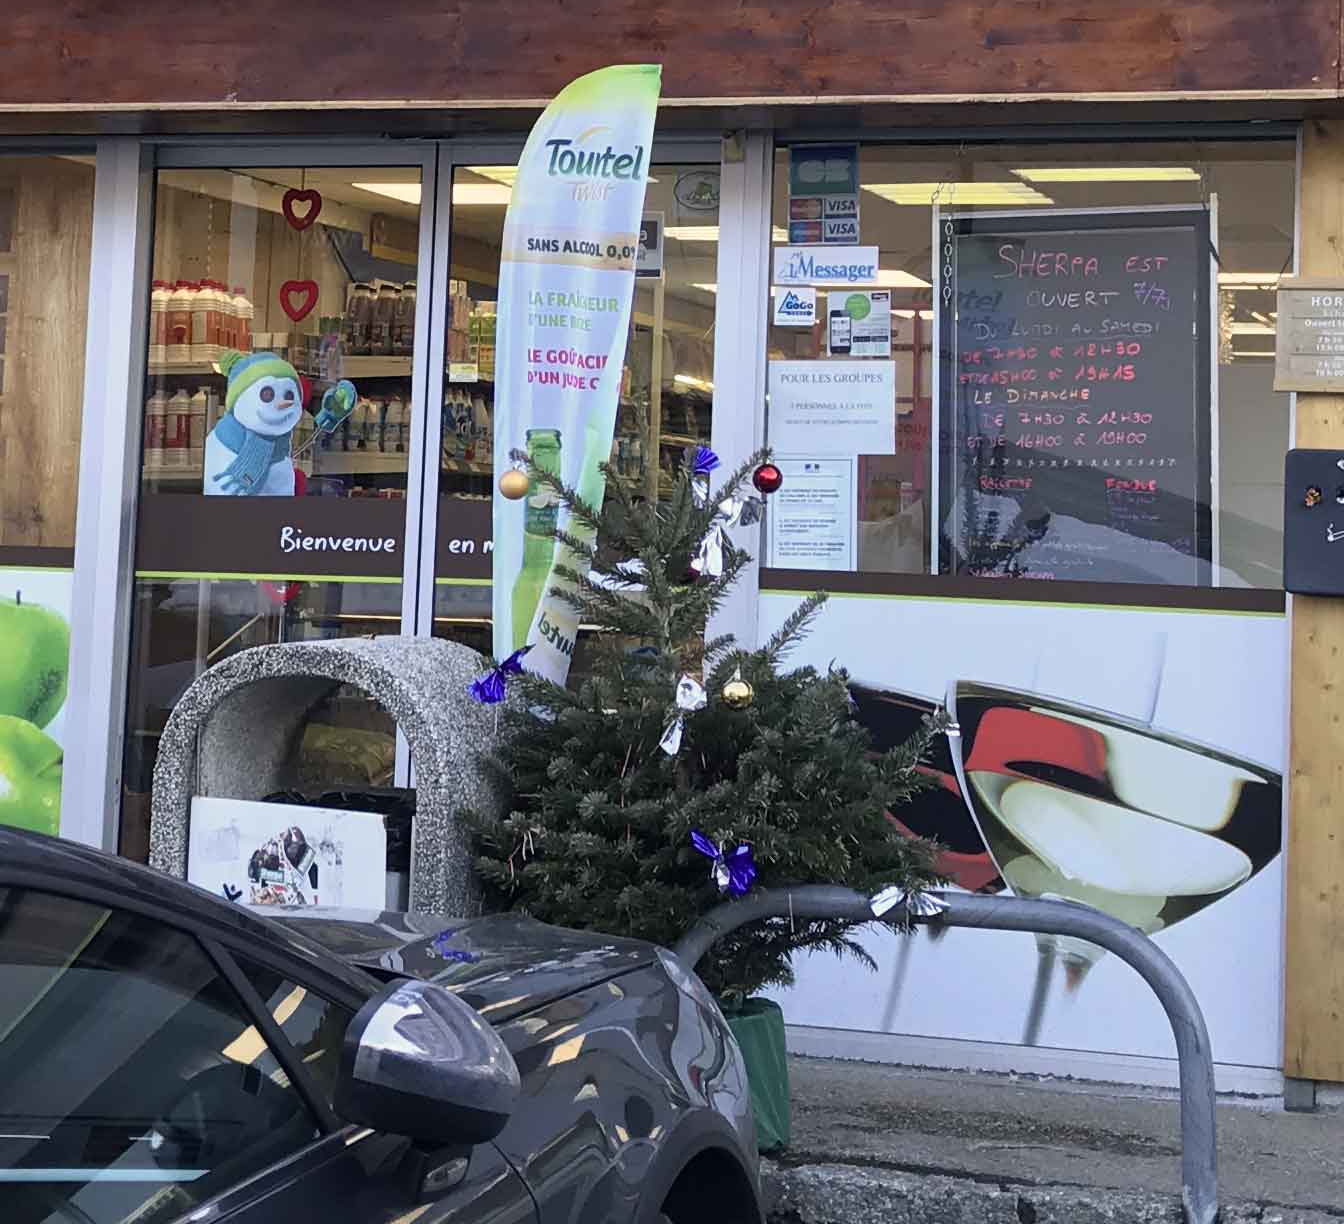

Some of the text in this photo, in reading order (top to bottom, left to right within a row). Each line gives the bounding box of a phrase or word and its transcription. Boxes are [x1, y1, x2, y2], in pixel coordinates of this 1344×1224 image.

[545, 137, 644, 181] Tourtel
[828, 200, 856, 211] VISA
[828, 223, 856, 234] VISA
[527, 238, 559, 252] SANS
[993, 244, 1168, 278] SHERPA EST
[1026, 290, 1120, 308] OUVERT
[528, 349, 542, 363] LE
[780, 372, 884, 384] POUR LES GROUPES
[973, 392, 993, 405] LE
[280, 526, 396, 553] Bienvenue
[448, 539, 474, 553] en
